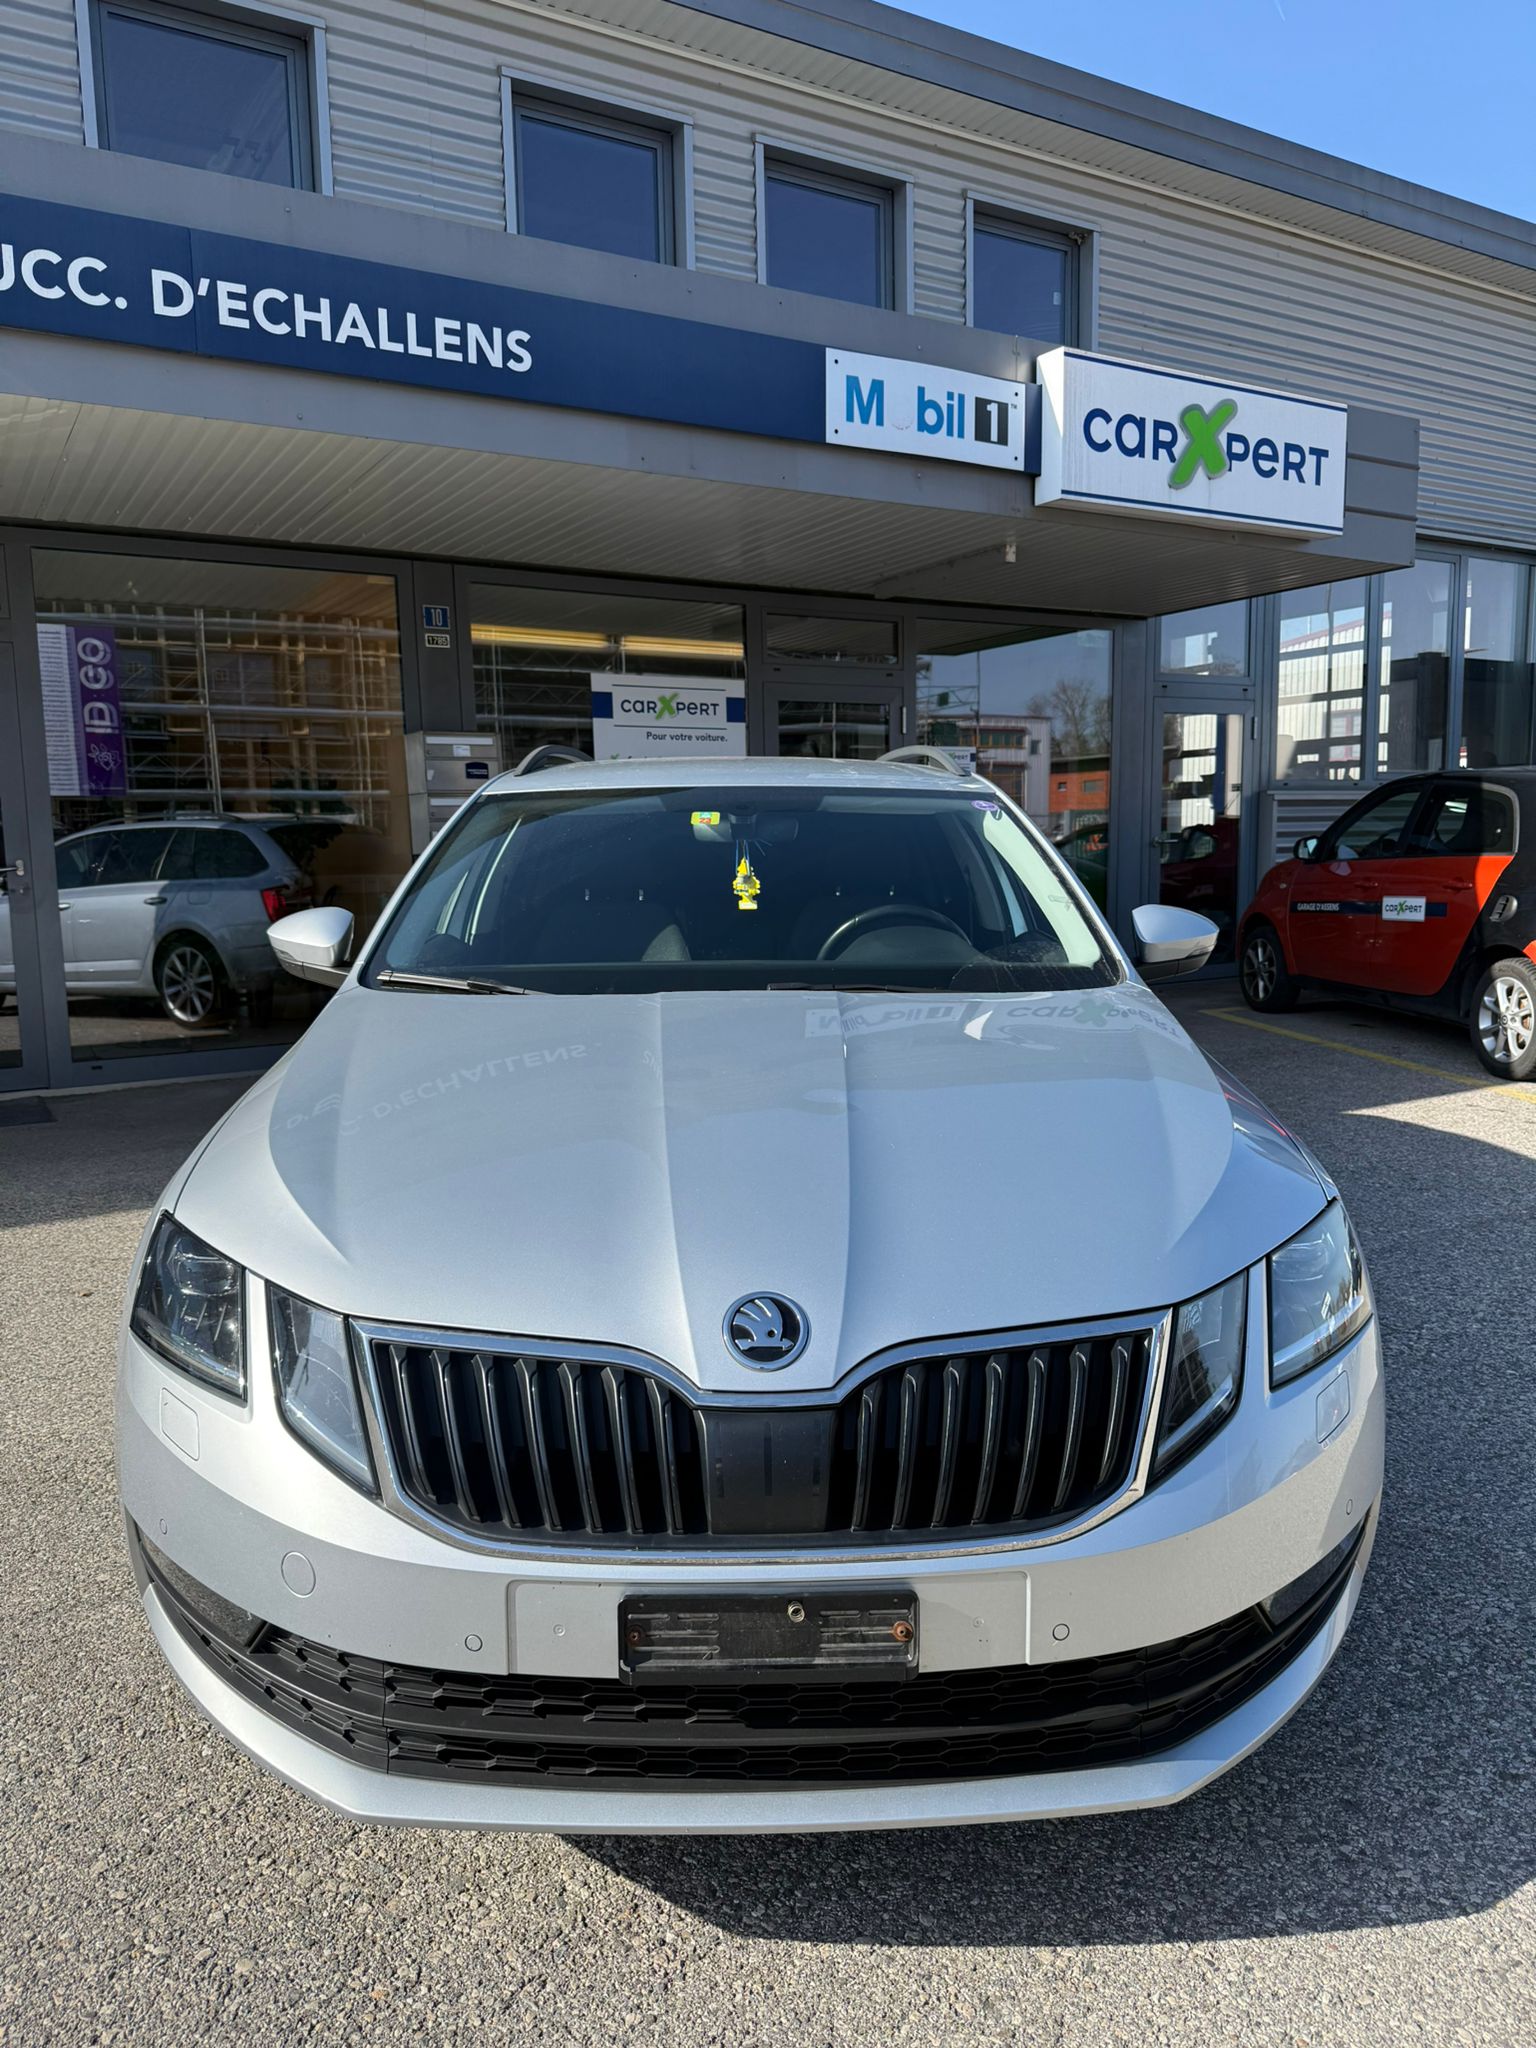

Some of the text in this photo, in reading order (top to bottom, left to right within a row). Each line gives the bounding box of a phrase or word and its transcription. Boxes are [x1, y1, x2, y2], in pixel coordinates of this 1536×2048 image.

[151, 268, 533, 374] D'ECHALLENS
[431, 608, 443, 626] 10
[646, 731, 728, 743] Pour votre voiture.
